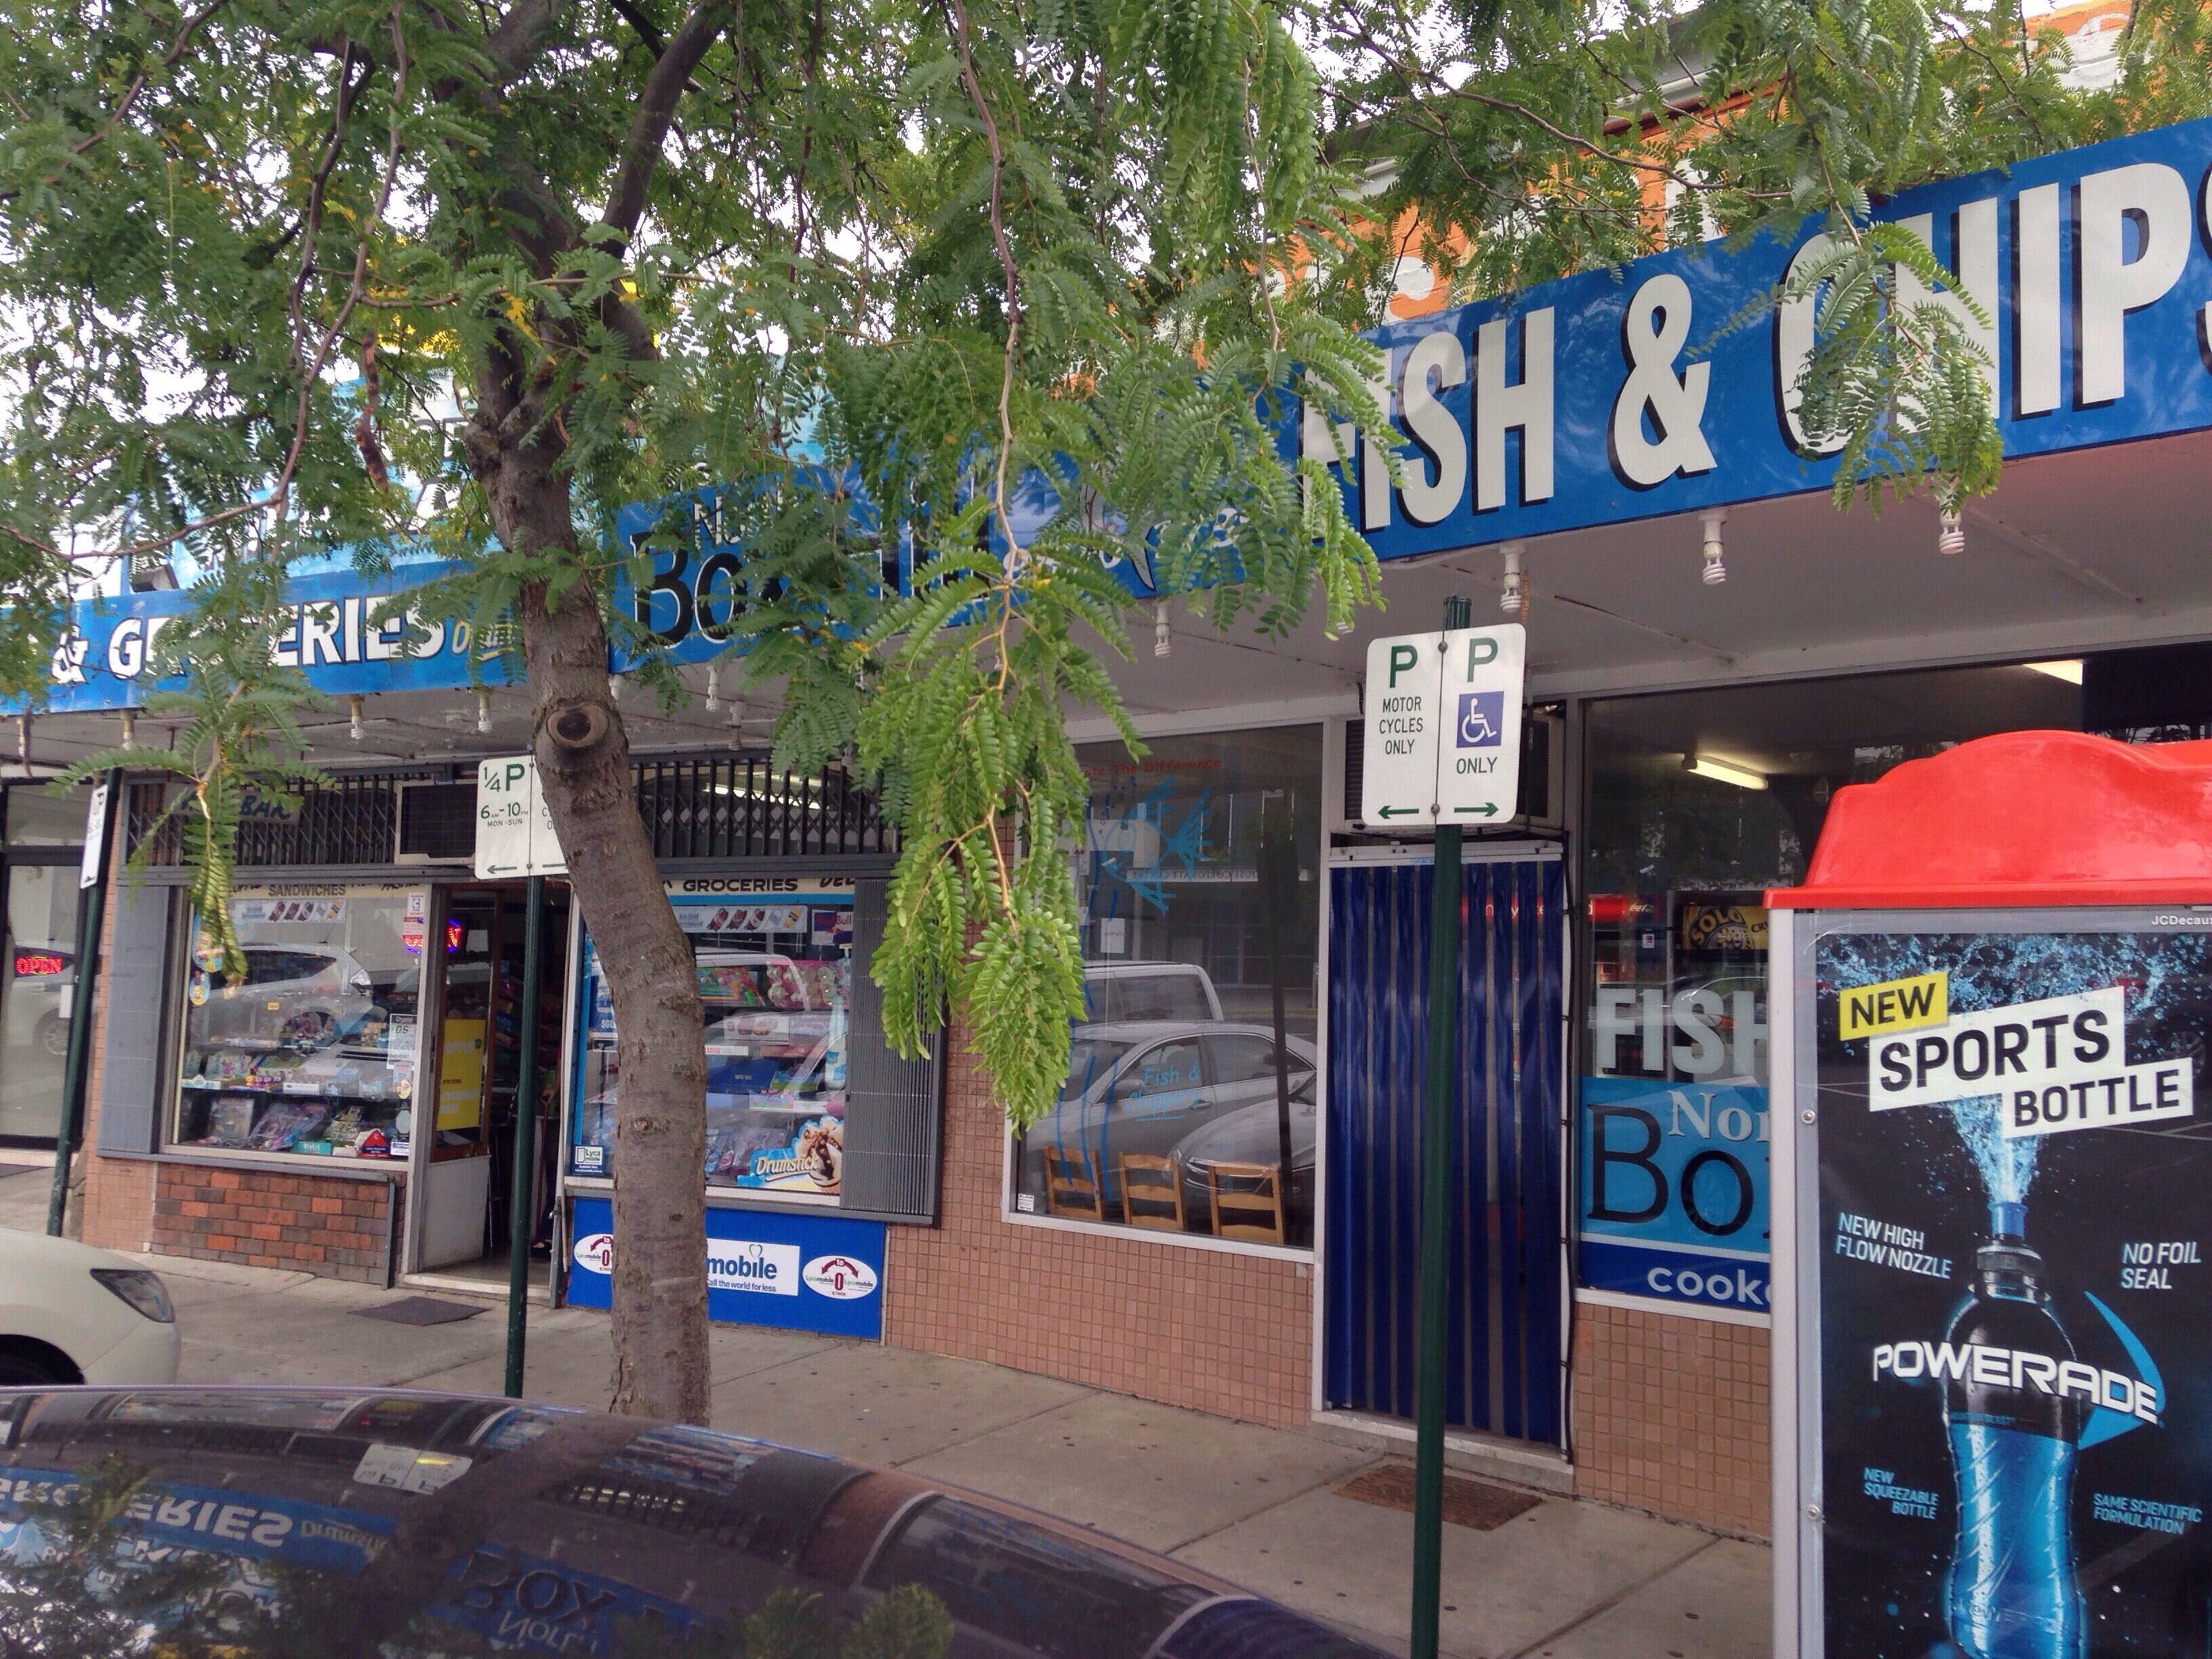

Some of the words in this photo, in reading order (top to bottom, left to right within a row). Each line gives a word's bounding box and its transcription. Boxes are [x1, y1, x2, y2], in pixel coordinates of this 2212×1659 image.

[1300, 306, 1554, 541] FISH
[1612, 274, 1717, 489] &
[1773, 160, 2212, 459] CHIP
[107, 595, 445, 680] GERIES
[1390, 644, 1418, 688] P
[1467, 637, 1498, 682] P
[1382, 696, 1422, 713] MOTOR
[1379, 718, 1423, 734] CYCLES
[1385, 739, 1415, 755] ONLY
[1456, 756, 1498, 774] ONLY
[268, 884, 346, 897] SANDWICHES
[683, 878, 798, 892] GROCERIES
[836, 915, 852, 925] Bull
[16, 958, 62, 974] OPEN
[1851, 982, 1936, 1029] NEW
[1596, 988, 1768, 1075] FISH
[1880, 1010, 2110, 1092] SPORTS
[2014, 1069, 2180, 1127] BOTTLE
[756, 1156, 817, 1175] Drumstick
[1839, 1212, 1882, 1240] NEW
[1883, 1223, 1925, 1251] HIGH
[1835, 1234, 1888, 1265] FLOW
[1887, 1247, 1954, 1280] NOZZLE
[2121, 1242, 2154, 1265] NO
[2156, 1241, 2202, 1265] FOIL
[718, 1279, 731, 1288] the
[731, 1281, 751, 1290] world
[752, 1282, 762, 1291] for
[762, 1284, 777, 1292] less
[1647, 1267, 1771, 1305] cook
[2120, 1267, 2173, 1290] SEAL
[1872, 1341, 2158, 1425] POWERADE
[1864, 1467, 1895, 1485] NEW
[1863, 1481, 1940, 1507] SQUEEZABLE
[1891, 1500, 1938, 1520] BOTTLE
[2093, 1492, 2129, 1511] SAME
[2129, 1498, 2203, 1523] SCIENTIFIC
[2093, 1506, 2185, 1535] FORMULATION
